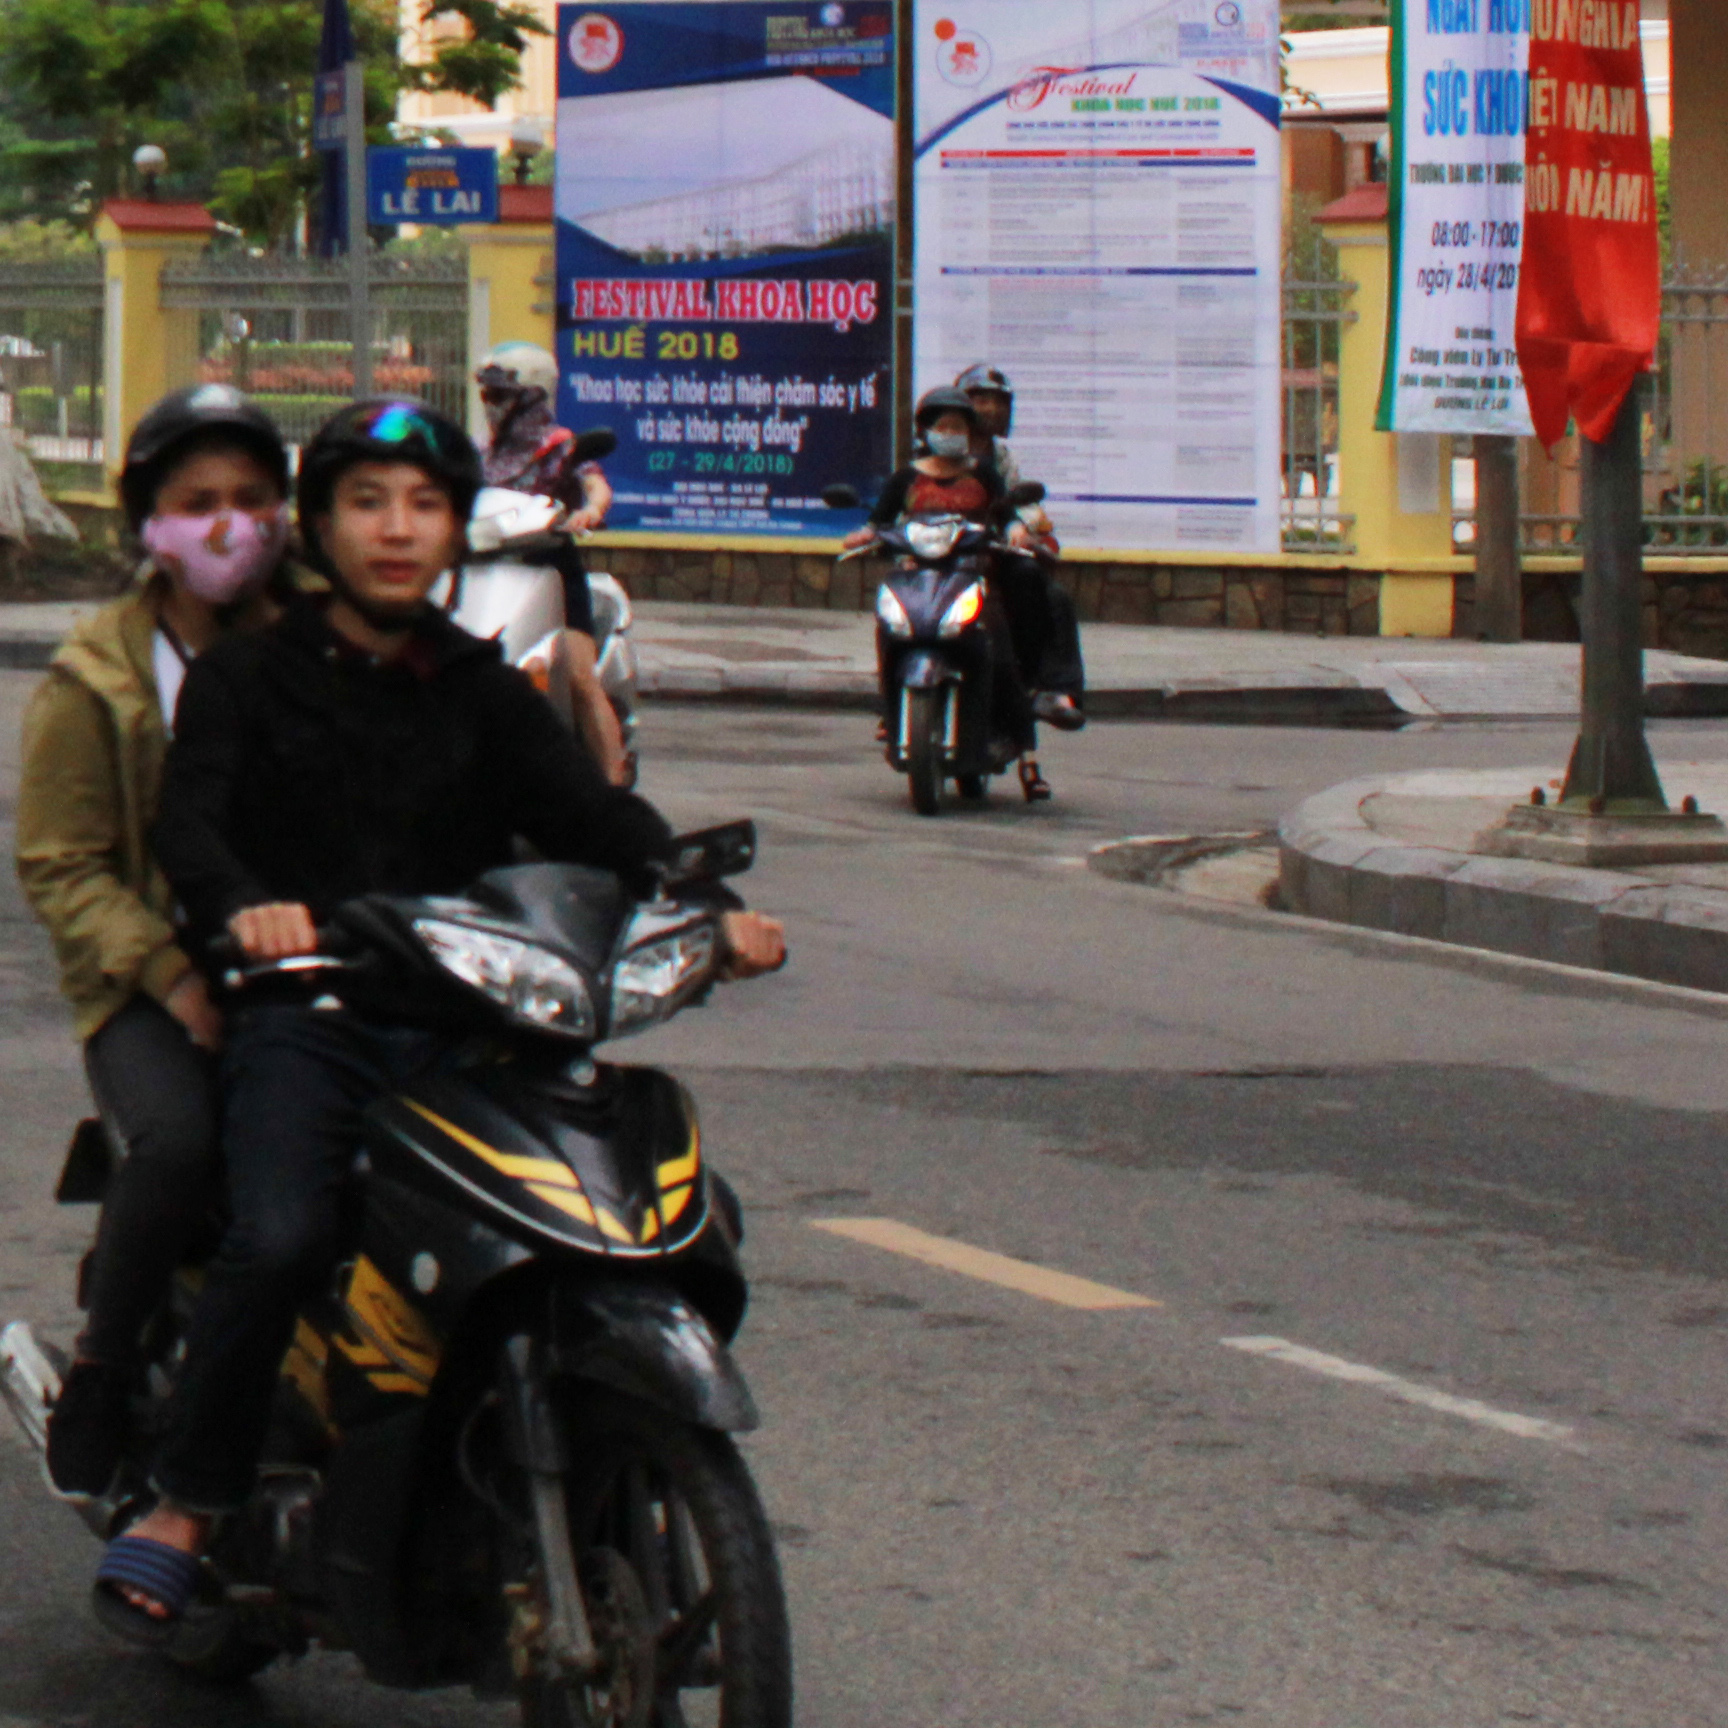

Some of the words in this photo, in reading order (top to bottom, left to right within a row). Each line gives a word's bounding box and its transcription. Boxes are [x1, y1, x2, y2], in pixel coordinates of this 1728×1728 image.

[1006, 65, 1137, 111] Festival
[1425, 60, 1468, 137] SỨC
[1565, 81, 1636, 135] NAM
[432, 190, 482, 214] LAI
[1431, 222, 1470, 247] 08:00
[1481, 222, 1520, 248] 17:00
[1417, 260, 1452, 297] ngày
[574, 278, 712, 322] FESTIVAL
[715, 278, 804, 322] KHOA
[807, 278, 878, 332] HỌC
[574, 322, 646, 357] HUẾ
[658, 332, 740, 360] 2018
[819, 375, 845, 407] sóc
[848, 384, 858, 413] y
[648, 451, 675, 472] (27
[695, 451, 793, 474] 29/4/2018)
